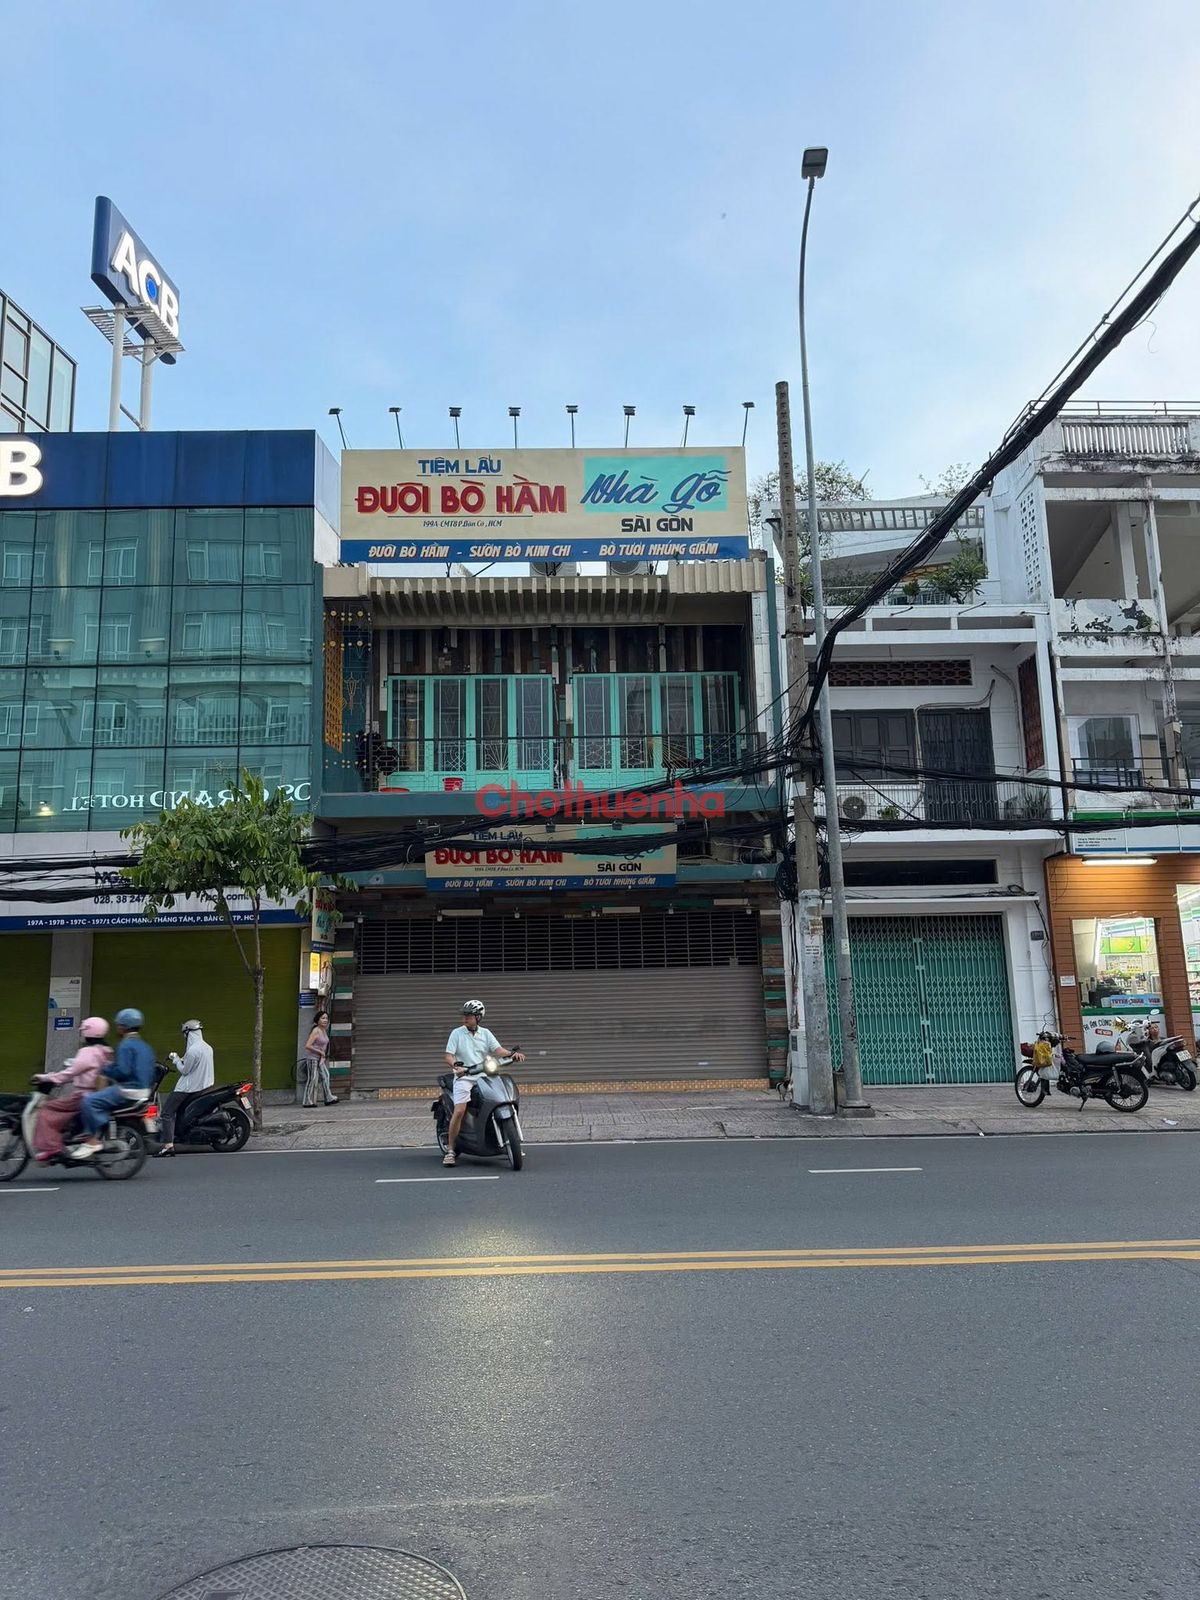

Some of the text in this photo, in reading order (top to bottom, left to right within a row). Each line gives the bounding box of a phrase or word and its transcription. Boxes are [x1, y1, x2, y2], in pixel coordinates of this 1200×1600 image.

[110, 231, 179, 339] ACB
[418, 456, 460, 477] TIỆM
[355, 474, 568, 514] ĐUÔI BÒ HẦM
[580, 469, 660, 505] Nhà
[621, 515, 693, 533] SÀI GÒN
[368, 544, 397, 558] ĐUÔI
[399, 542, 417, 558] BÒ
[420, 541, 450, 558] HẦM
[504, 542, 521, 557] BÒ
[525, 544, 550, 557] KIM
[552, 544, 571, 557] CHI
[599, 541, 616, 556] BÒ
[619, 541, 645, 556] TƯƠI
[648, 540, 686, 556] NHÚNG
[688, 538, 719, 555] GIẤM
[597, 861, 642, 872] SÀI GÒN
[555, 878, 567, 886] CHI
[111, 916, 131, 925] CÁCH
[203, 914, 218, 922] BÀN
